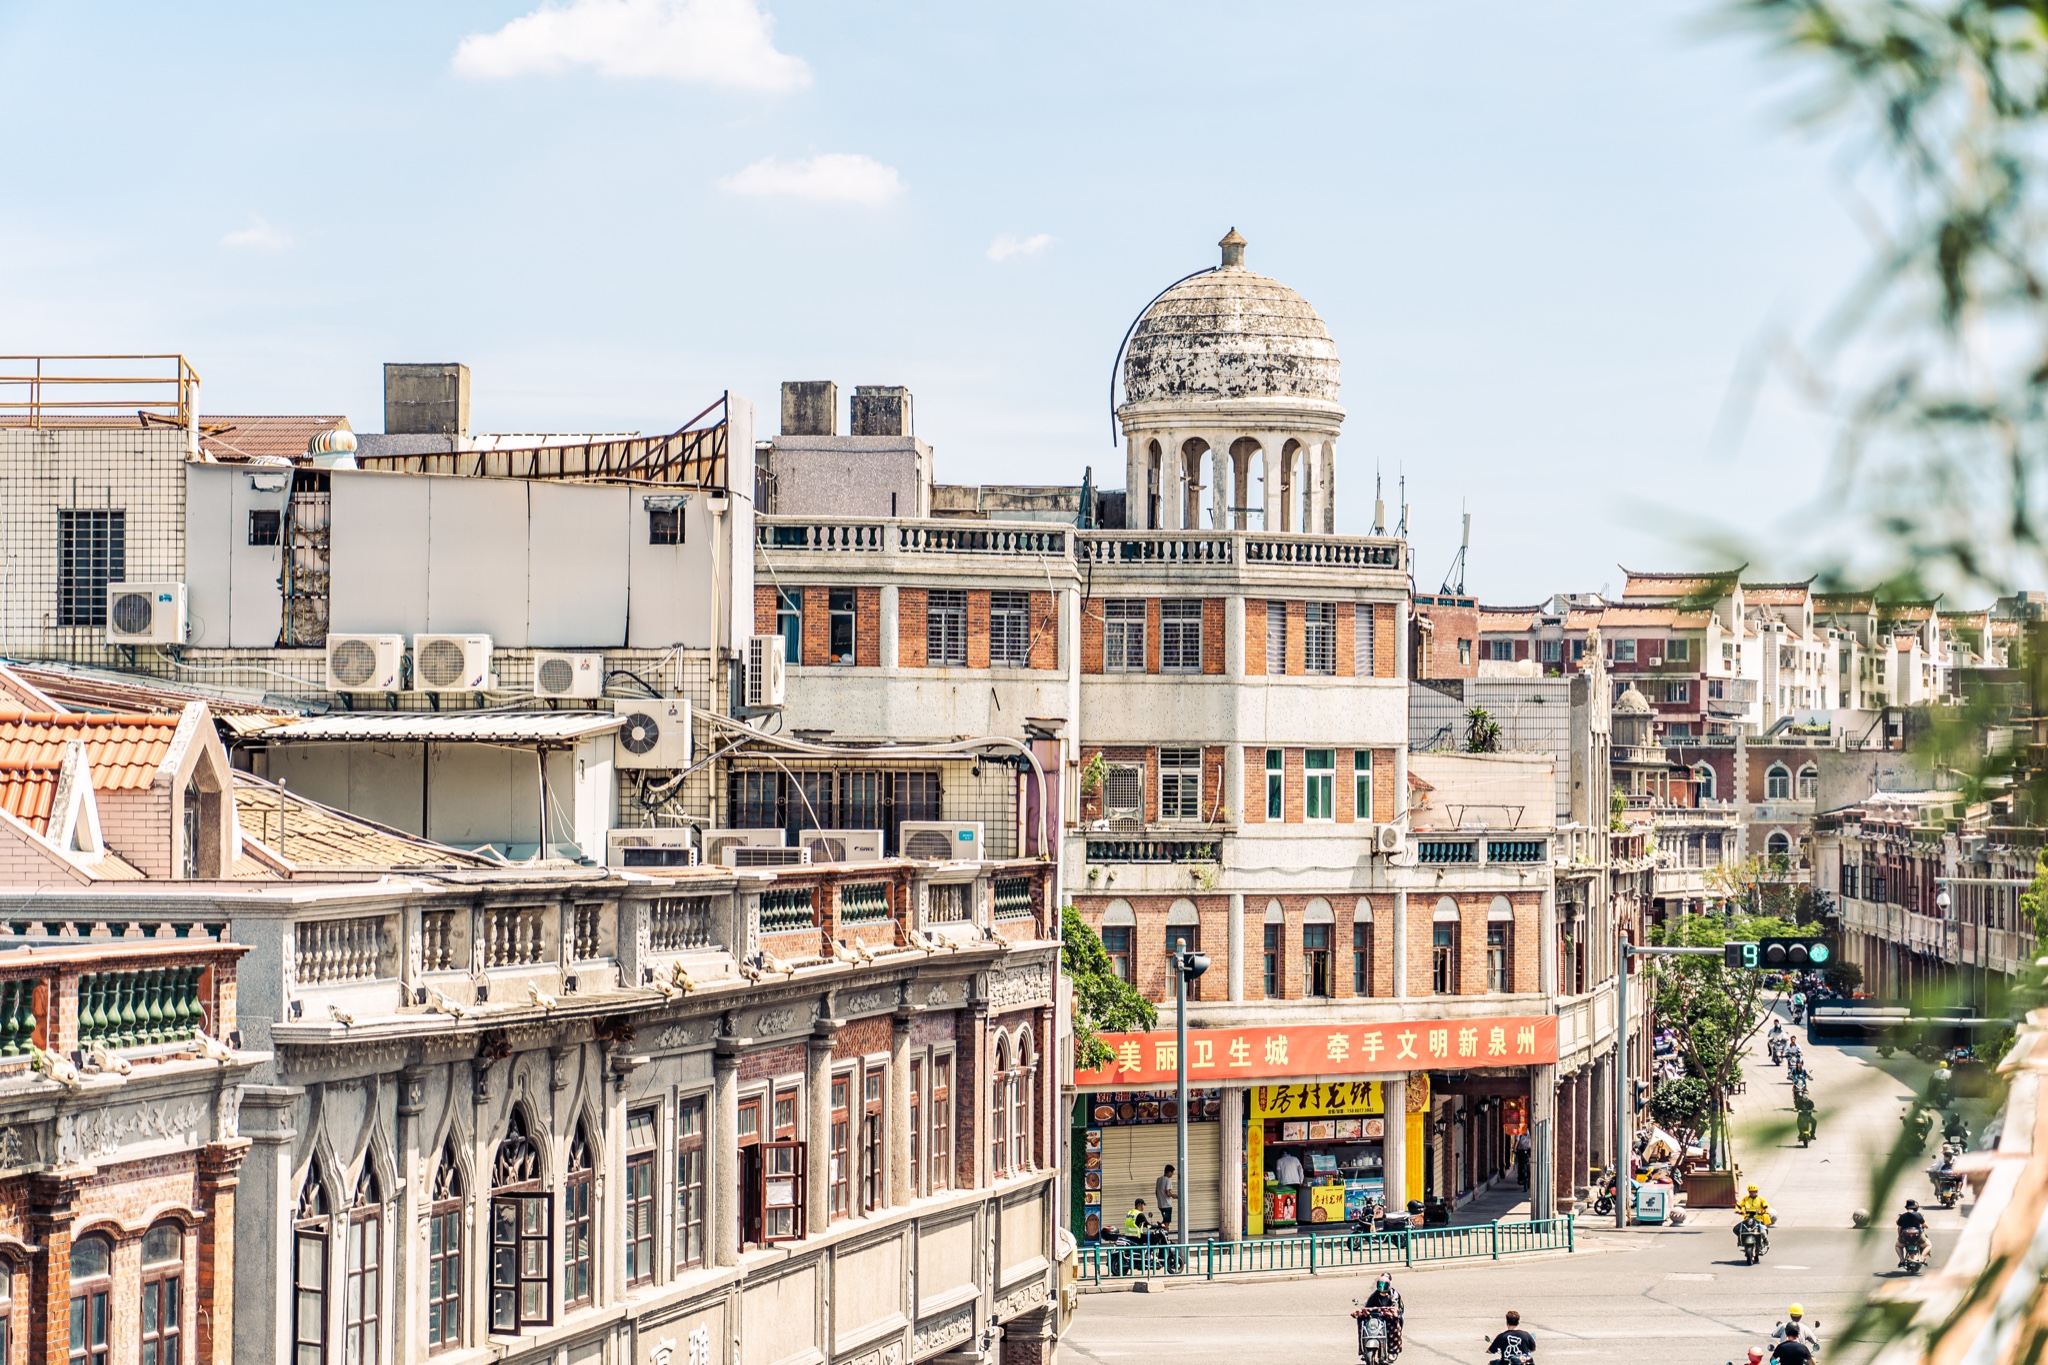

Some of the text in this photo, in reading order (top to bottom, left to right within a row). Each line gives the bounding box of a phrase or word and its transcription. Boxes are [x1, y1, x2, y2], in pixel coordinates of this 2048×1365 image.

[1743, 944, 1758, 968] 9
[1080, 1026, 1536, 1074] 美丽卫生城 牵手文明新泉州
